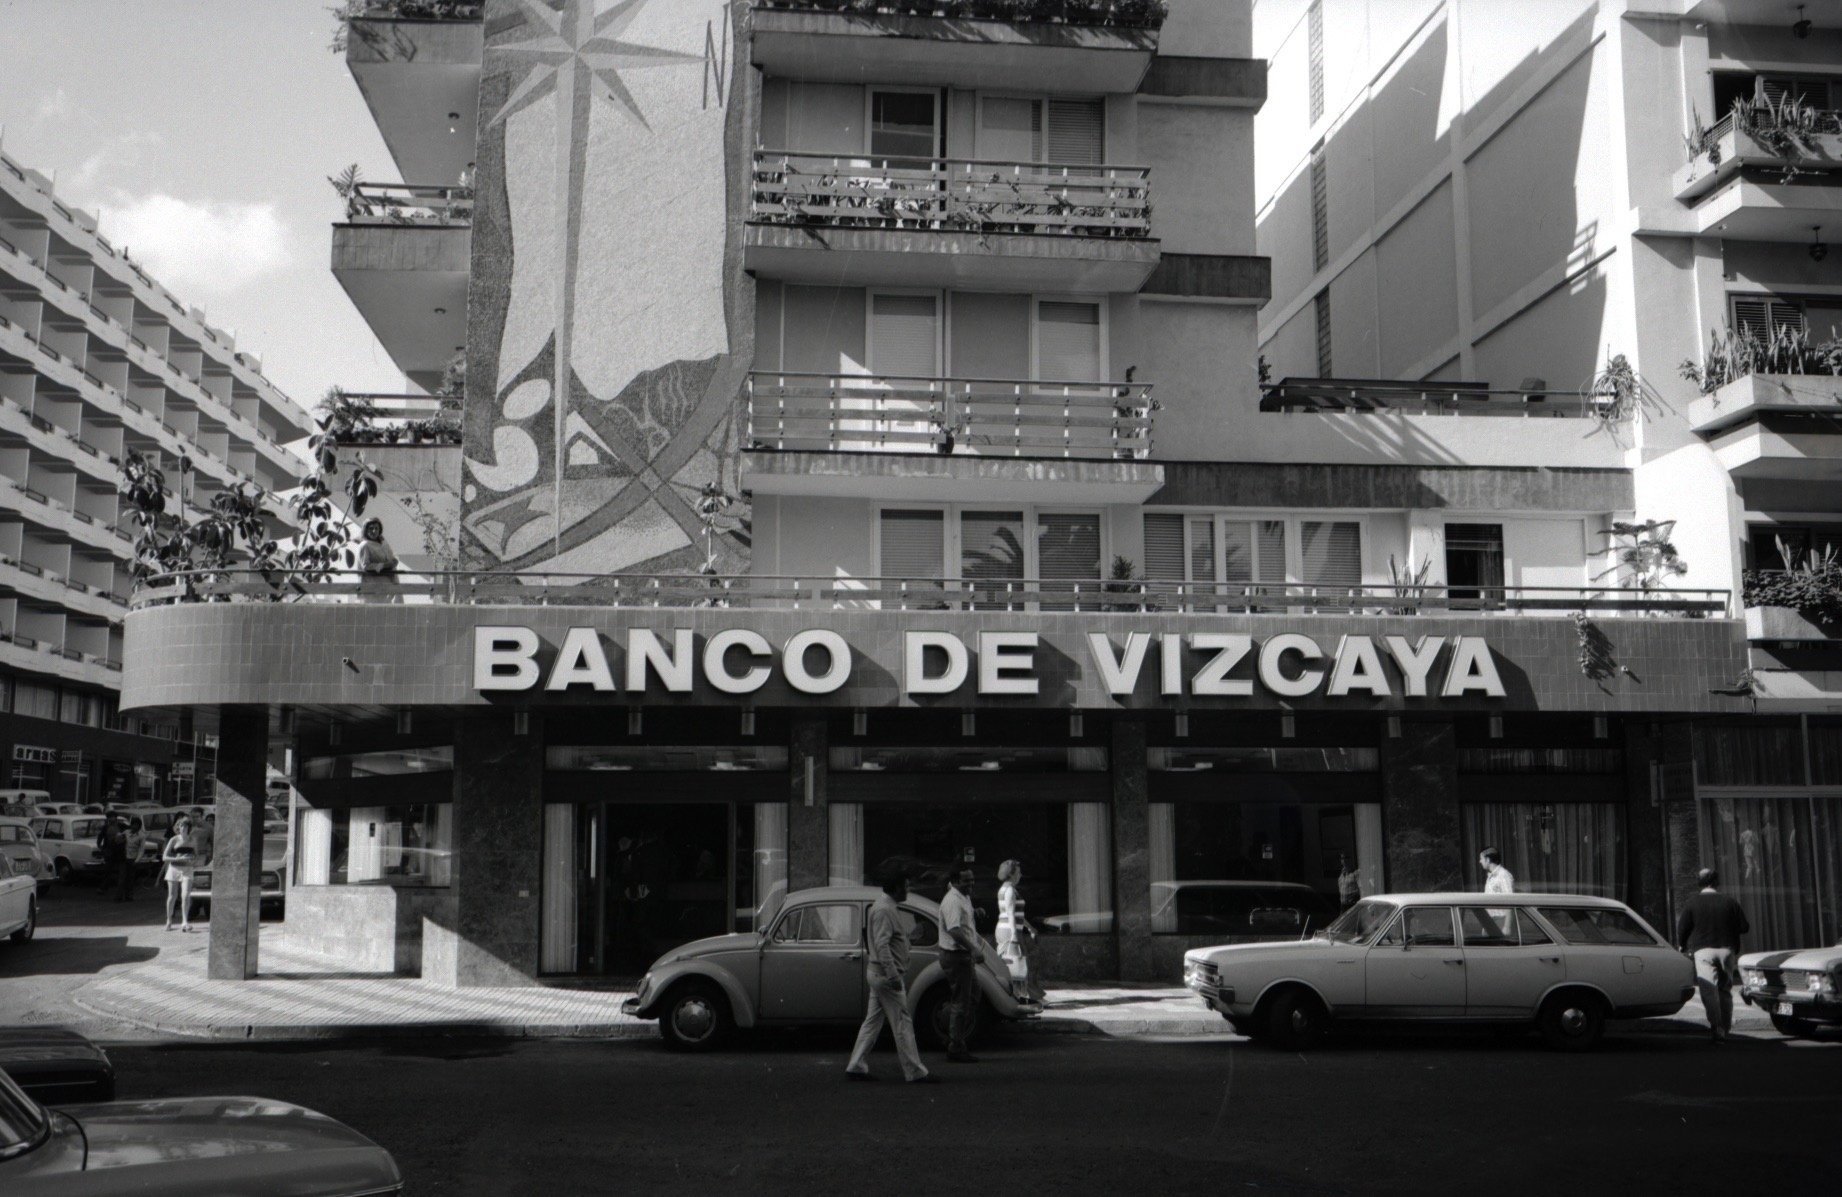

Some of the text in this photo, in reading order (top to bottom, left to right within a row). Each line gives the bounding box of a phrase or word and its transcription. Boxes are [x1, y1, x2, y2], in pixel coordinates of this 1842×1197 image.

[702, 3, 730, 110] N
[472, 625, 1508, 697] BANCO DE VIZCAYA
